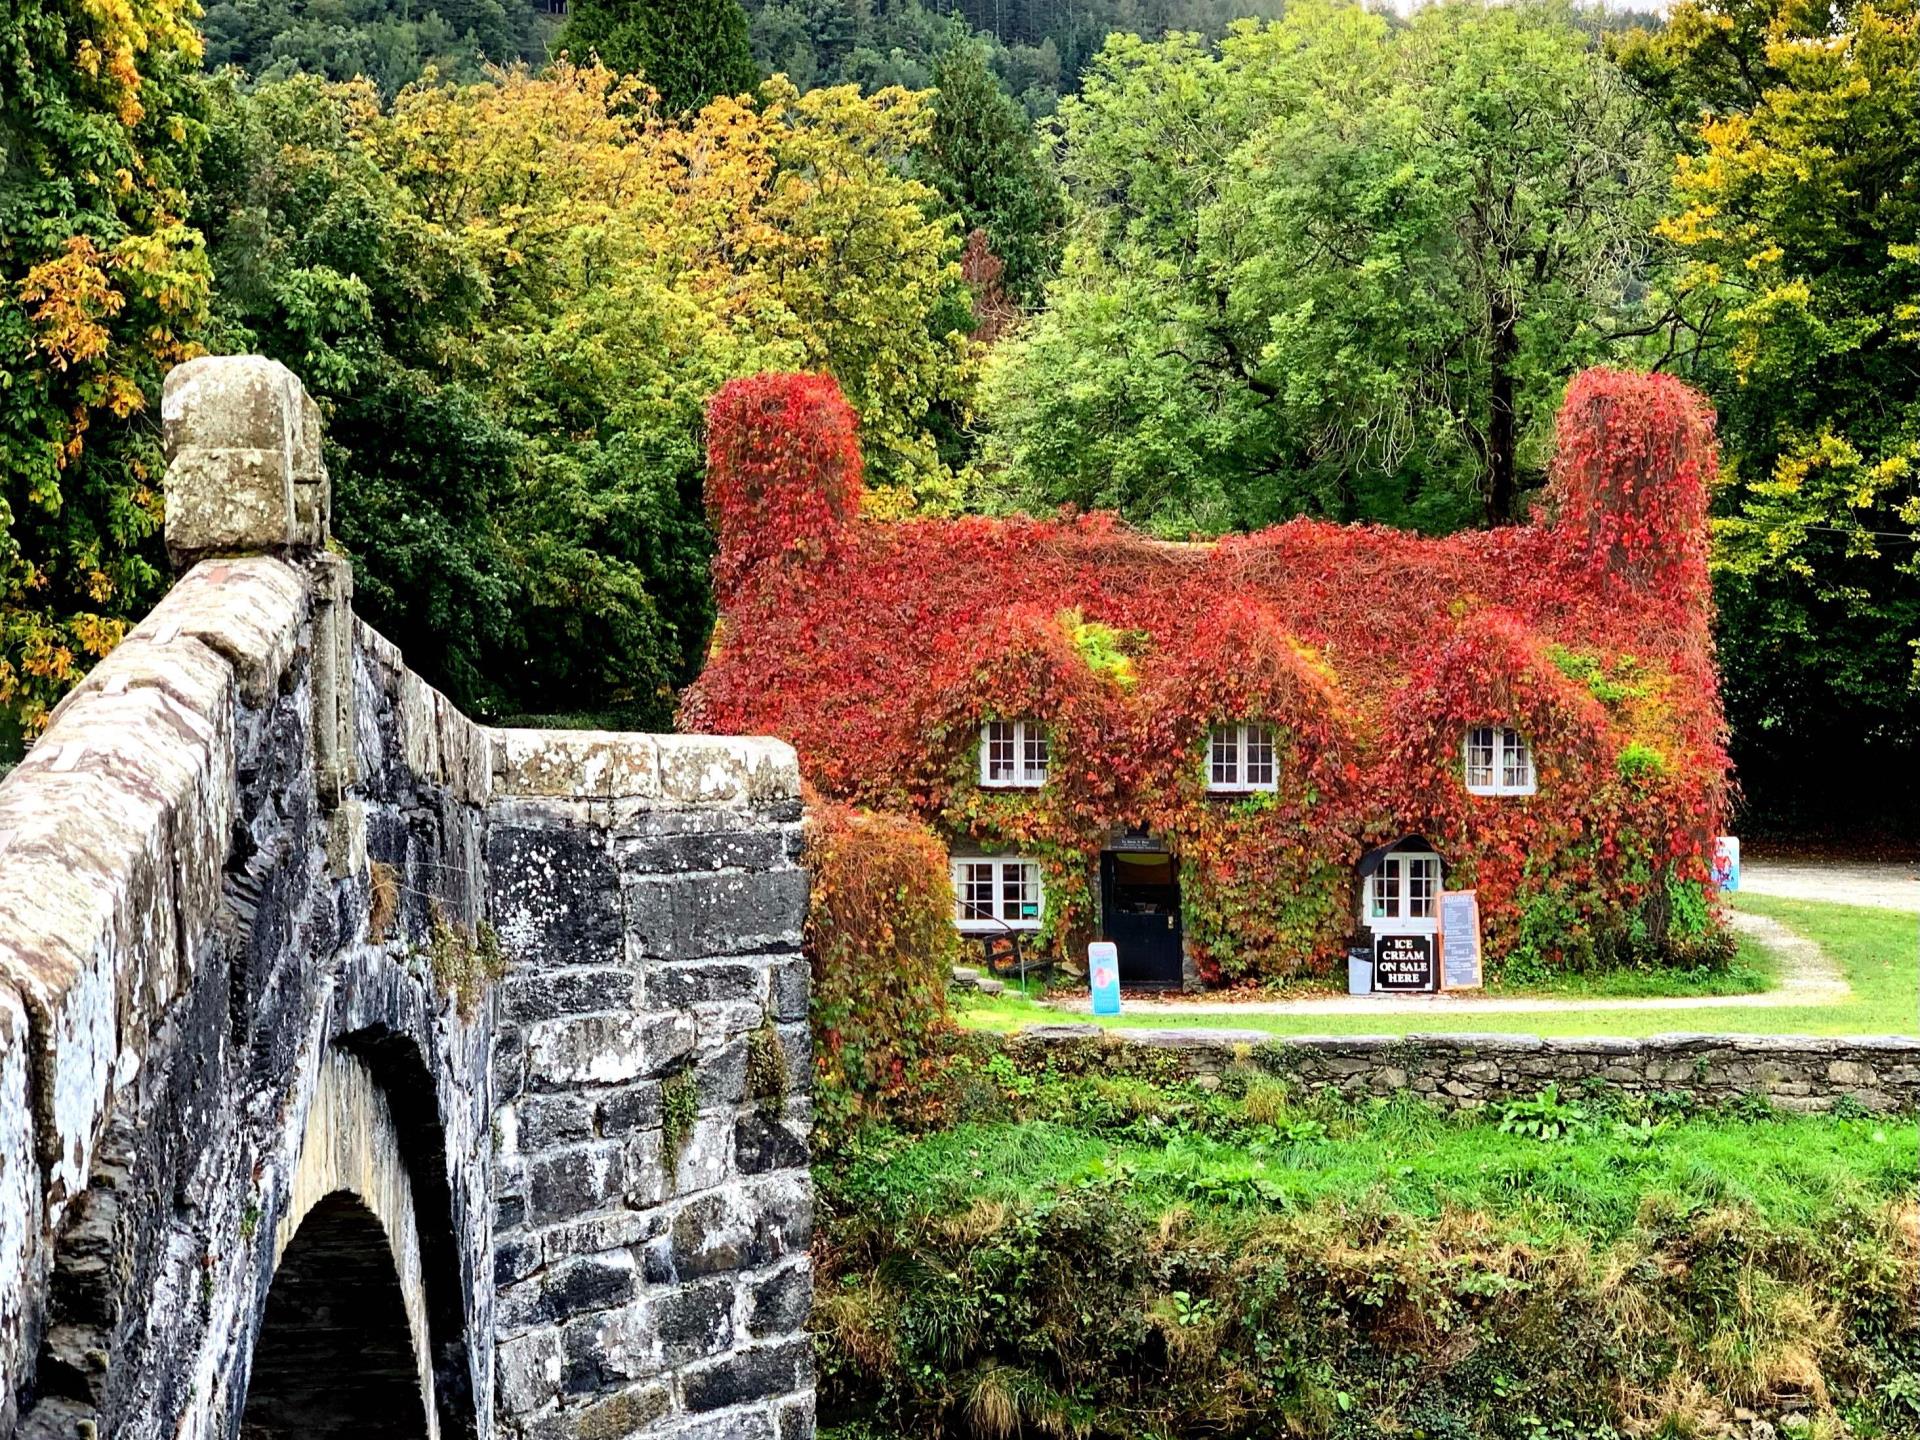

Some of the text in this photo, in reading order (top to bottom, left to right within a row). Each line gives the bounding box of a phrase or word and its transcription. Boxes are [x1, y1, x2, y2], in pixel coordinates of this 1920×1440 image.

[1394, 939, 1413, 949] ICE
[1382, 950, 1425, 960] CREAM
[1379, 962, 1428, 972] ON SALE
[1387, 973, 1420, 983] HERE
